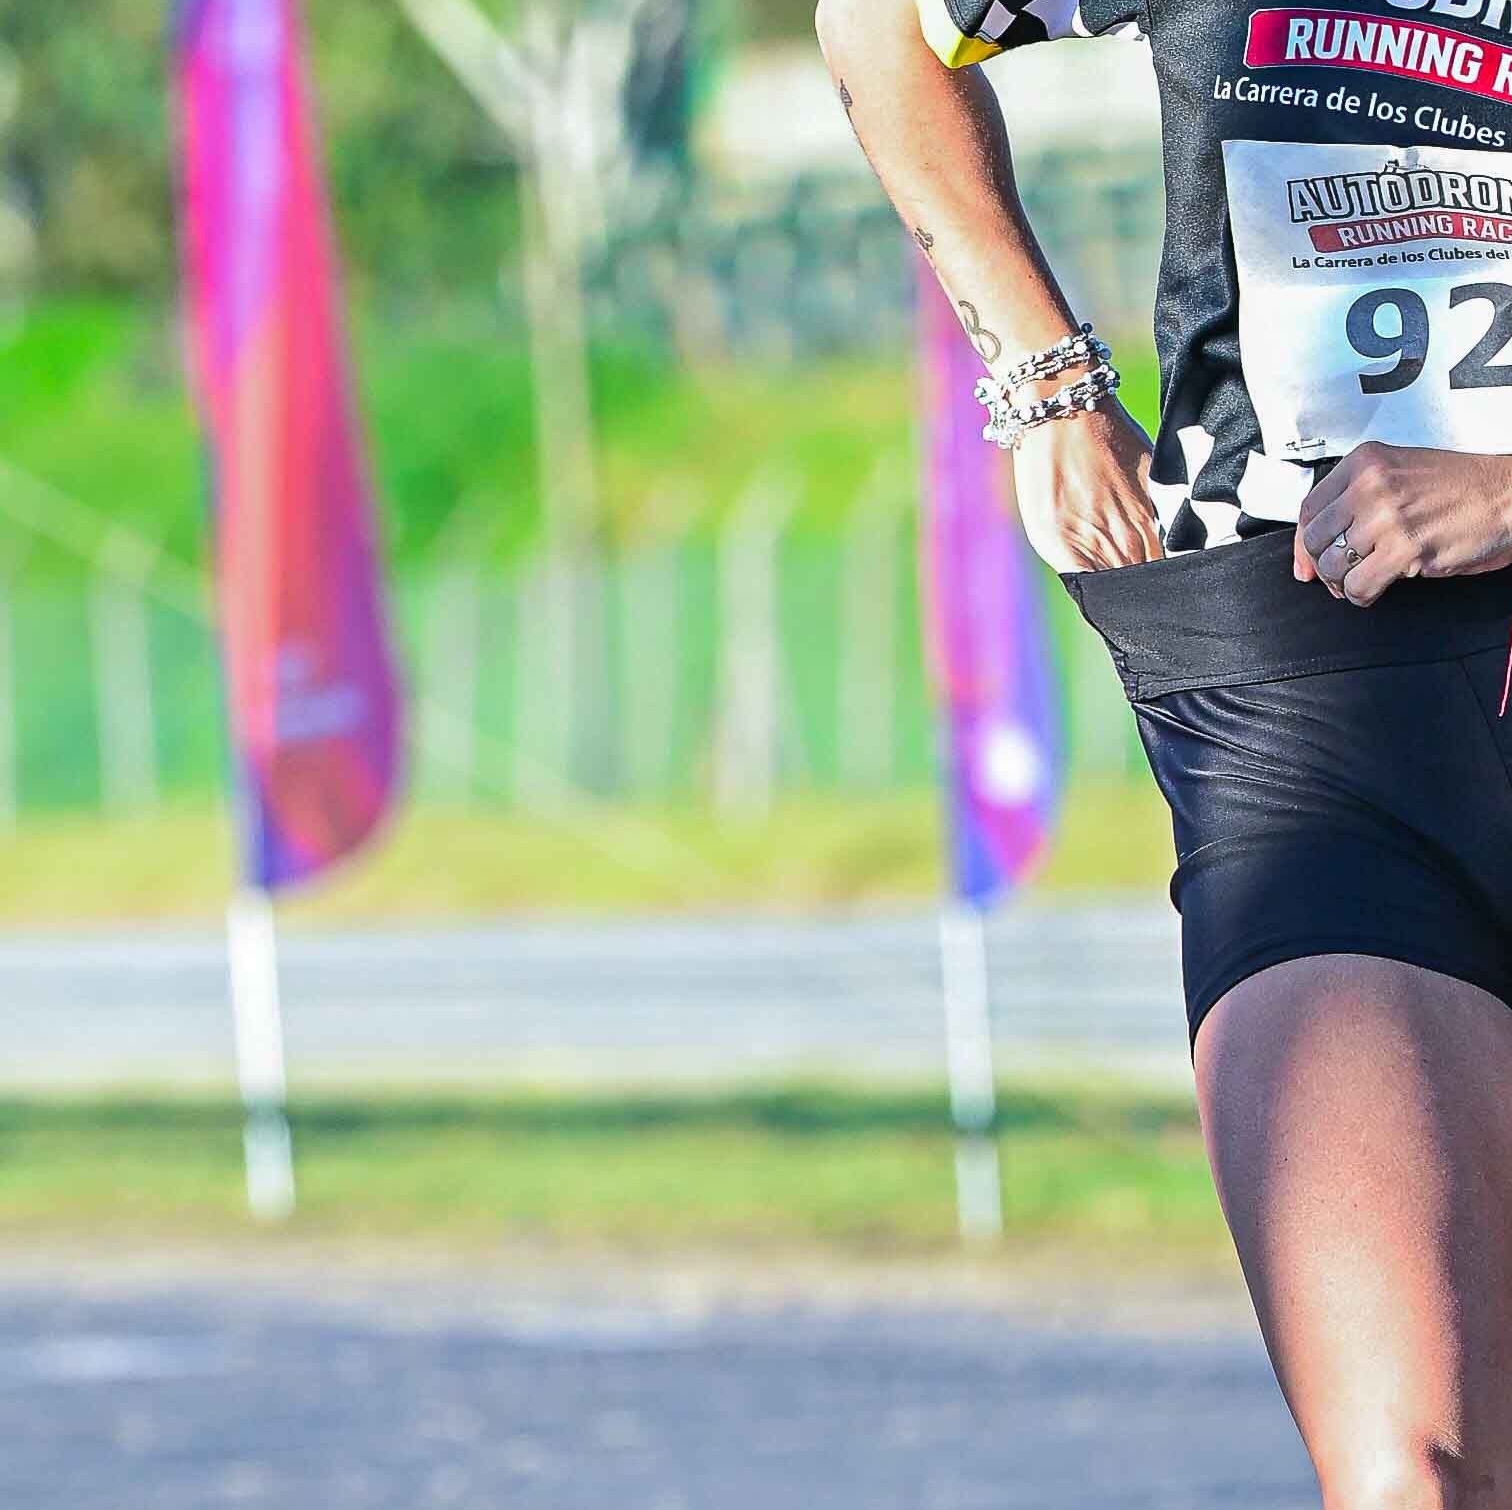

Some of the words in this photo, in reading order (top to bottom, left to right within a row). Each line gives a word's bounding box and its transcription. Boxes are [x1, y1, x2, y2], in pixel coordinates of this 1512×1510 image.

[1285, 19, 1483, 84] RUNNING
[1213, 74, 1231, 100] La
[1235, 76, 1318, 108] Carrera
[1326, 87, 1361, 114] de
[1368, 93, 1408, 124] los
[1414, 106, 1506, 147] Clubes
[1337, 215, 1452, 247] RUNNING
[1292, 256, 1310, 269] La
[1315, 254, 1373, 268] Carrera
[1376, 252, 1398, 265] de
[1402, 250, 1424, 263] los
[1428, 247, 1482, 261] Clubes
[1485, 247, 1510, 260] del
